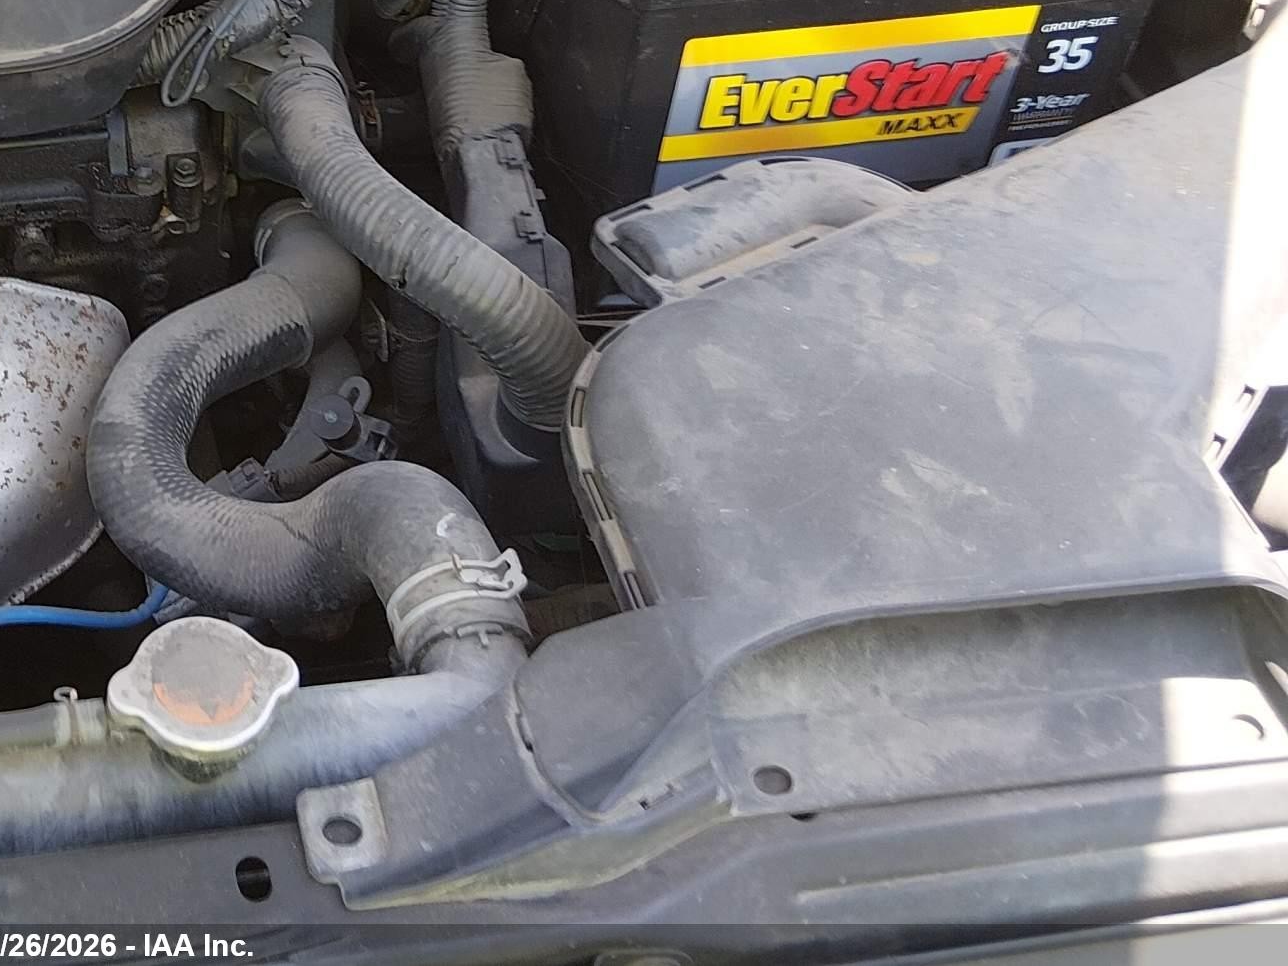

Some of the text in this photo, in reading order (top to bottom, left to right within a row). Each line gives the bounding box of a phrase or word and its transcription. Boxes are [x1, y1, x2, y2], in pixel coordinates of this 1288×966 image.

[1041, 17, 1118, 32] GROUP SIZE
[1038, 36, 1099, 73] 35
[699, 50, 1010, 130] EverStart
[1010, 93, 1089, 112] 3-Year
[877, 113, 966, 135] MAXX
